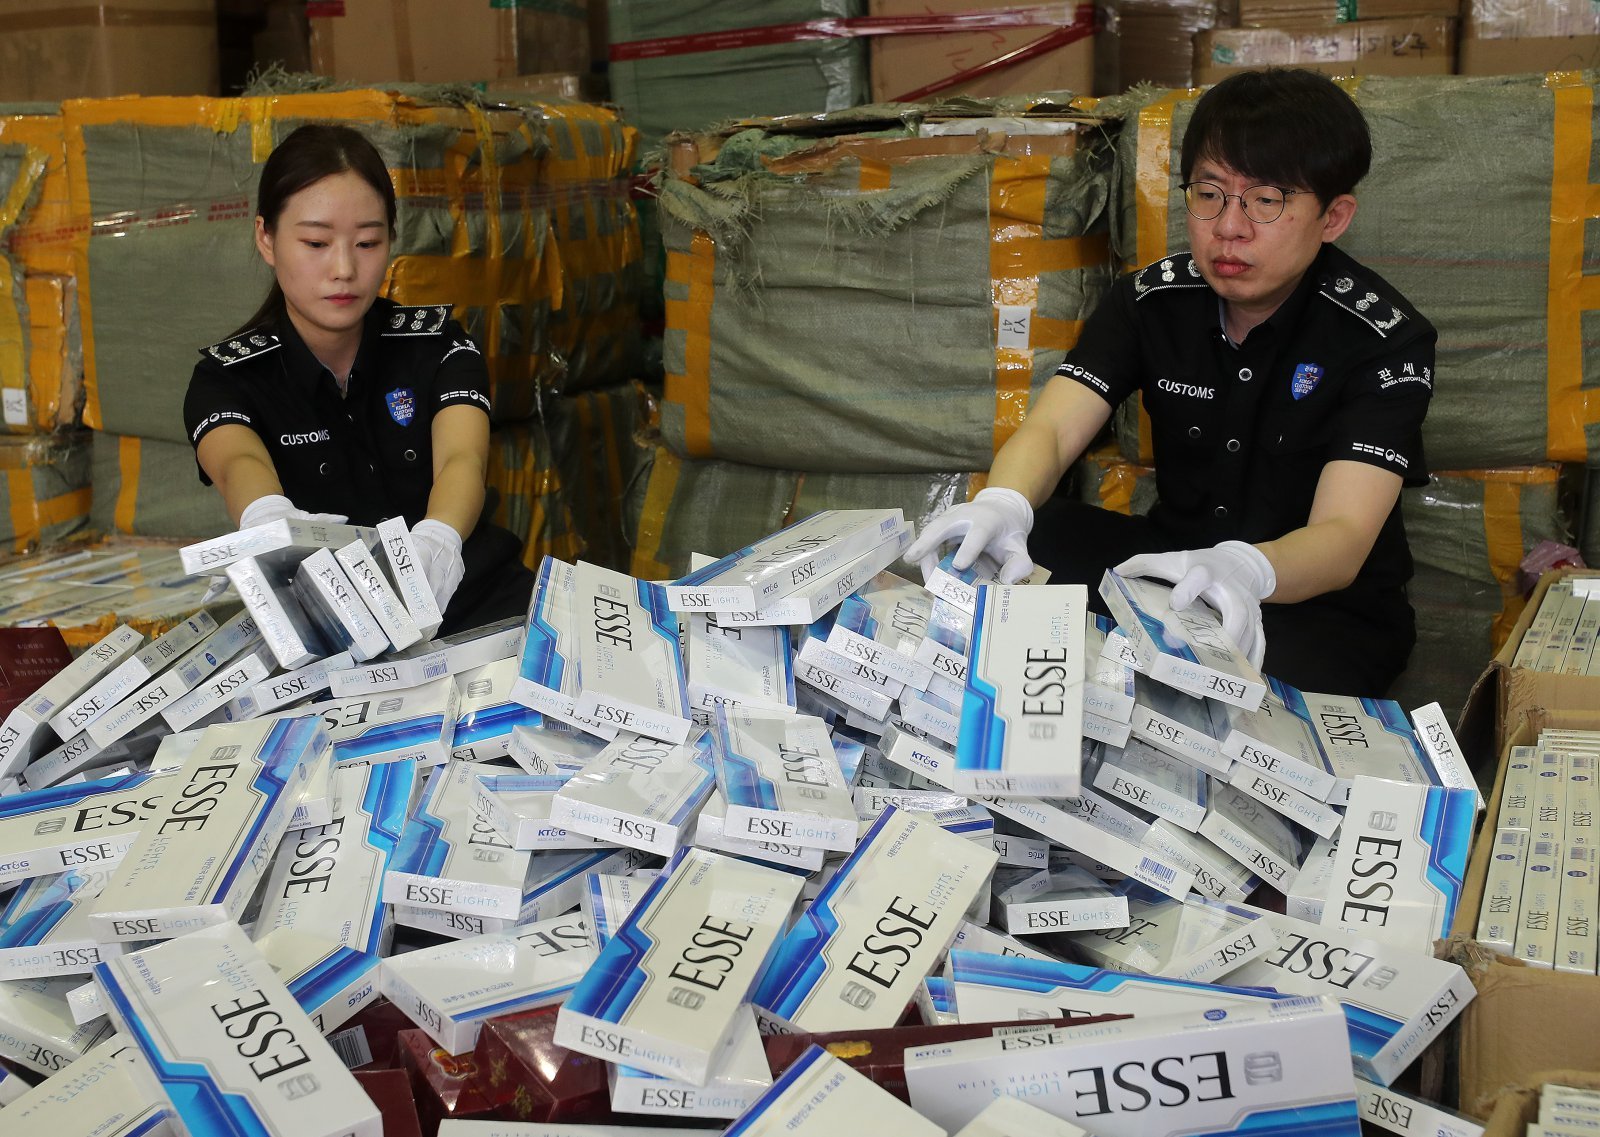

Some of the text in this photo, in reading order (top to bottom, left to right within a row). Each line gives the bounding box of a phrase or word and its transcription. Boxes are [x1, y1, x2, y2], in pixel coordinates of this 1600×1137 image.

[1001, 319, 1012, 333] 41
[1012, 317, 1026, 336] YJ
[1157, 377, 1216, 400] CUSTOMS
[1380, 378, 1399, 389] KOREA
[280, 429, 331, 446] CUSTOMS
[200, 542, 238, 566] ESSE
[757, 534, 838, 563] ESSE
[352, 559, 384, 601] ESSE
[388, 535, 426, 611] ESSE LIGHTS
[790, 560, 817, 586] ESSE
[836, 572, 856, 597] ESSE
[319, 566, 352, 609] ESSE
[680, 593, 741, 608] ESSE LIGHTS
[762, 582, 779, 595] KT&G
[594, 595, 633, 652] ESSE
[766, 606, 798, 618] LIGHTS
[891, 600, 929, 641] ESSE
[91, 643, 118, 664] ESSE
[156, 640, 177, 659] ESSE
[844, 638, 915, 679] ESSE LIGHTS
[367, 666, 399, 685] ESSE
[850, 663, 889, 687] ESSE
[1021, 615, 1068, 718] ESSE LIGHTS
[181, 669, 251, 718] ESSE LIGHTS
[271, 674, 311, 701] ESSE
[804, 665, 872, 709] ESSE LIGHTS
[1170, 666, 1247, 699] ESSE LIGHTS
[66, 673, 133, 729] ESSE LIGHTS
[104, 685, 170, 732] ESSE LIGHTS
[593, 702, 672, 734] ESSE LIGHTS
[922, 712, 961, 745] LIGHTS
[1321, 712, 1369, 749] ESSE
[61, 737, 90, 764] ESSE
[1145, 717, 1218, 759] ESSE LIGHTS
[1425, 721, 1454, 762] ESSE
[530, 750, 549, 776] ESSE
[608, 736, 678, 775] ESSE
[778, 742, 831, 788] ESSE
[910, 749, 941, 770] KT&G
[1239, 744, 1315, 788] ESSE LIGHTS
[477, 792, 496, 817] ESSE
[1110, 777, 1185, 820] ESSE LIGHTS
[1251, 776, 1323, 824] ESSE LIGHTS
[1508, 794, 1528, 809] ESSE
[143, 761, 241, 871] ESSE LIGHTS
[569, 807, 657, 843] ESSE LIGHTS
[1008, 800, 1048, 825] LIGHTS
[1100, 812, 1135, 837] LIGHTS
[1539, 805, 1559, 823] ESSE
[1572, 809, 1593, 828] ESSE
[538, 828, 567, 838] KT&G
[747, 816, 838, 842] ESSE LIGHTS
[0, 859, 30, 872] KT&G
[59, 842, 115, 867] ESSE
[282, 815, 346, 900] ESSE
[1028, 850, 1047, 860] KT&G
[1218, 828, 1287, 883] ESSE LIGHTS
[937, 864, 971, 911] SUPER SLIM
[1191, 863, 1228, 900] ESSE
[1340, 834, 1403, 928] ESSE
[405, 884, 500, 908] ESSE LIGHTS
[1489, 893, 1513, 914] ESSE
[113, 918, 208, 936] ESSE LIGHTS
[446, 911, 485, 935] ESSE
[844, 871, 953, 990] ESSE LIGHTS
[1027, 909, 1112, 929] ESSE LIGHTS
[1526, 909, 1550, 932] ESSE
[1566, 915, 1589, 938] ESSE
[1488, 925, 1500, 940] KT&G
[8, 946, 102, 968] ESSE LIGHTS
[668, 914, 755, 992] ESSE
[1217, 933, 1258, 967] ESSE
[1264, 931, 1376, 990] ESSE
[1523, 942, 1538, 960] KT&G
[1567, 950, 1580, 966] KT&G
[348, 984, 373, 1008] KT&G
[211, 960, 312, 1083] ESSE LIGHTS
[416, 995, 443, 1034] ESSE
[1391, 988, 1460, 1062] ESSE LIGHTS
[580, 1024, 682, 1069] ESSE LIGHTS
[1000, 1031, 1064, 1052] ESSE
[1067, 1050, 1237, 1118] ESSE
[640, 1087, 748, 1110] ESSE LIGHTS
[1367, 1092, 1414, 1130] ESSE
